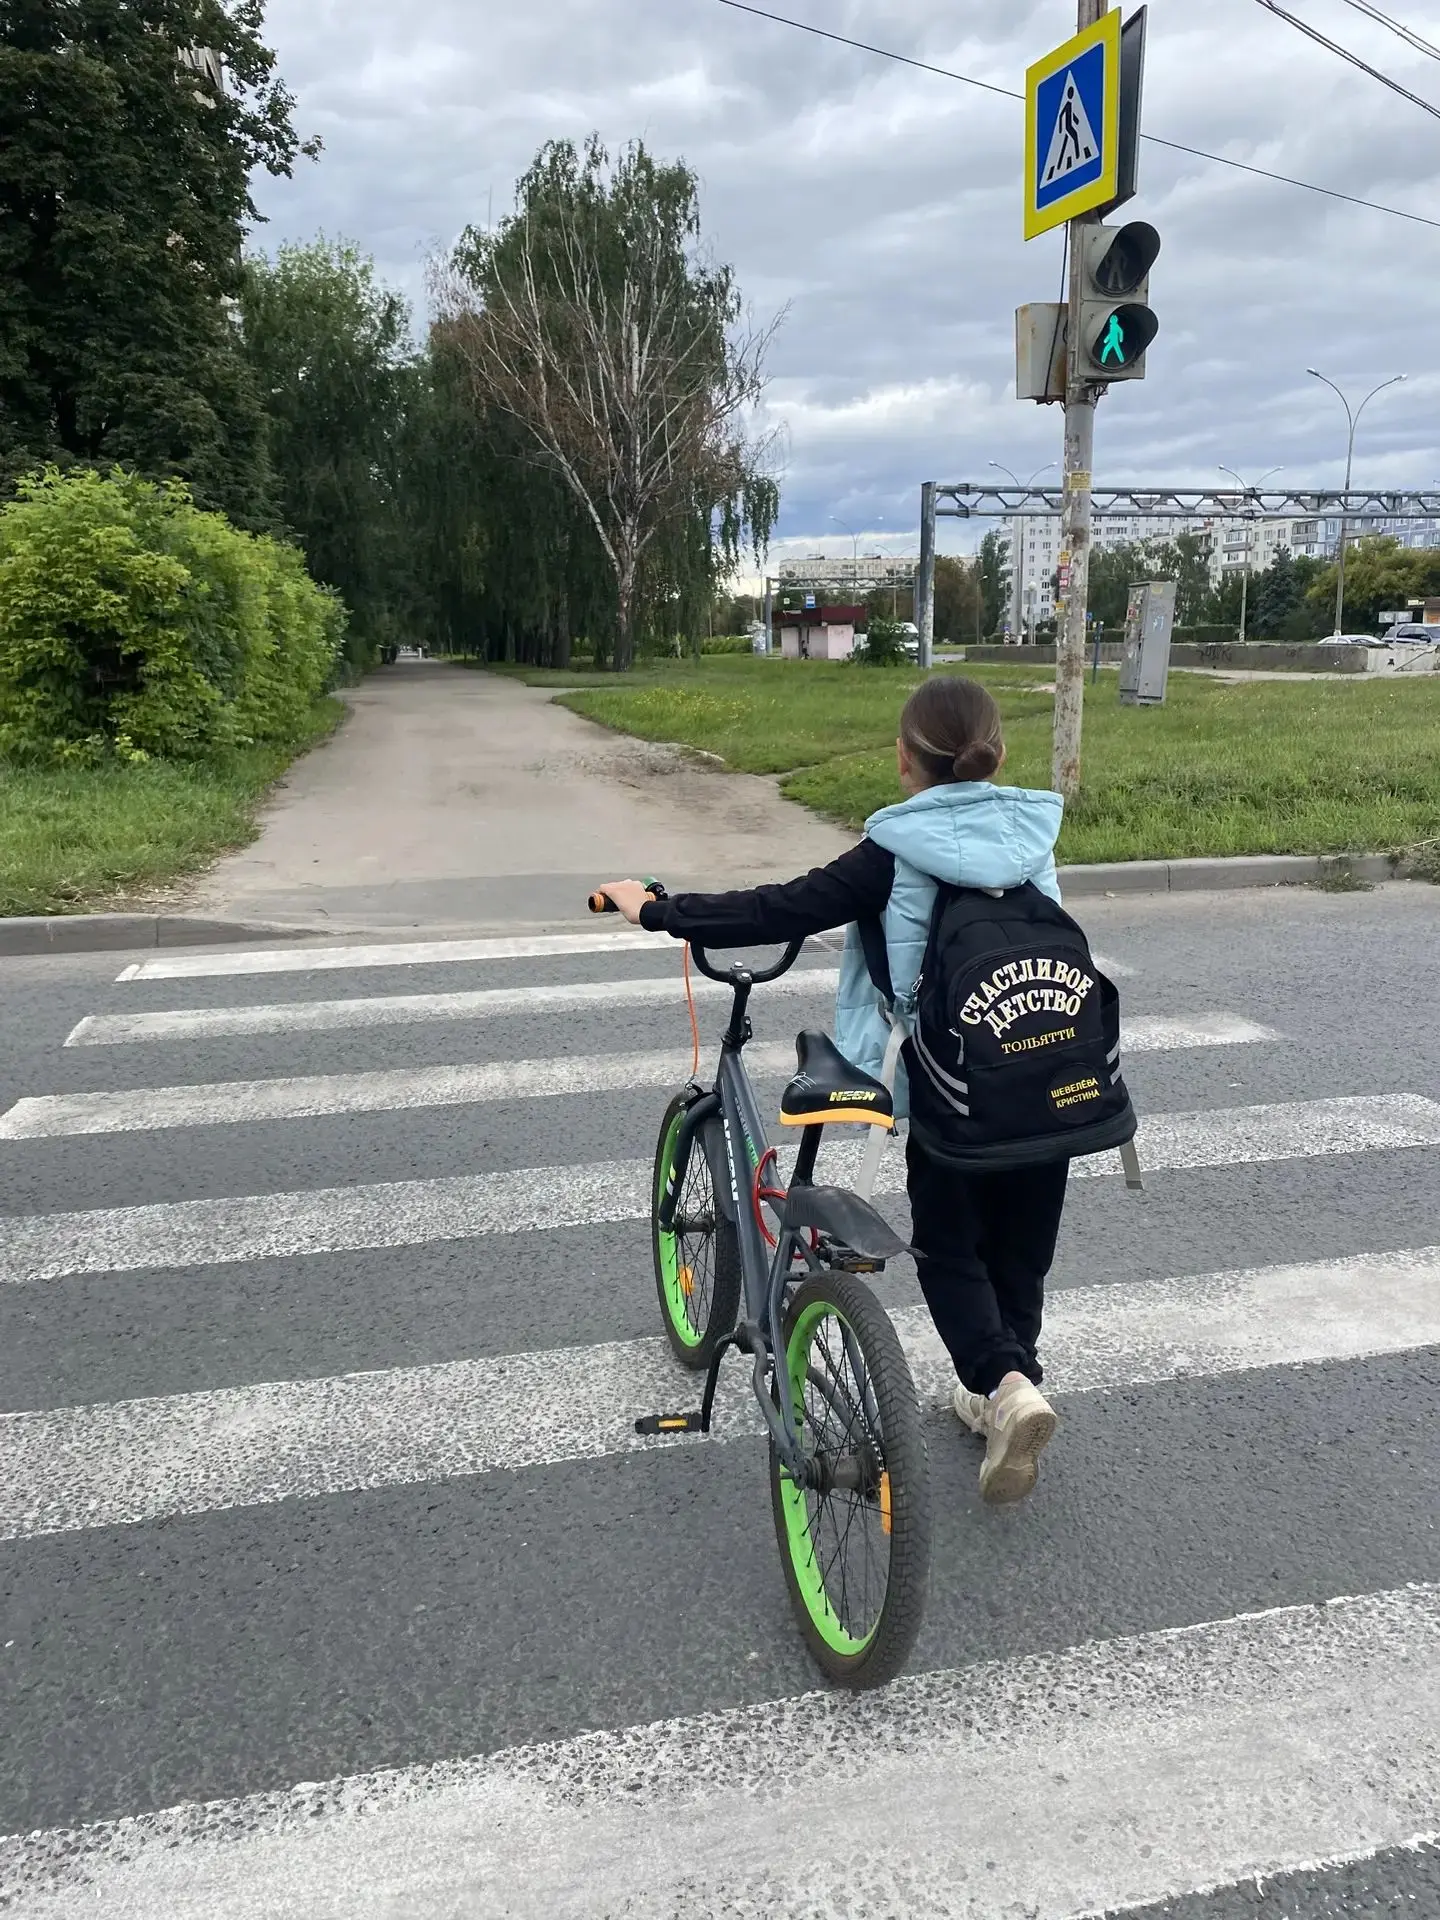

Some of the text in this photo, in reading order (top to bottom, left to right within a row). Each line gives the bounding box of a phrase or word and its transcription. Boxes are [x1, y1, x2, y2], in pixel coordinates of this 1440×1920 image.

[959, 958, 1095, 1025] СЧАСТЛИВОЕ
[983, 988, 1081, 1039] ДЕТСТВО
[1001, 1026, 1076, 1054] ТОЛЬЯТТИ
[829, 1090, 877, 1102] NEON
[1055, 1088, 1100, 1109] КРИСТИНА
